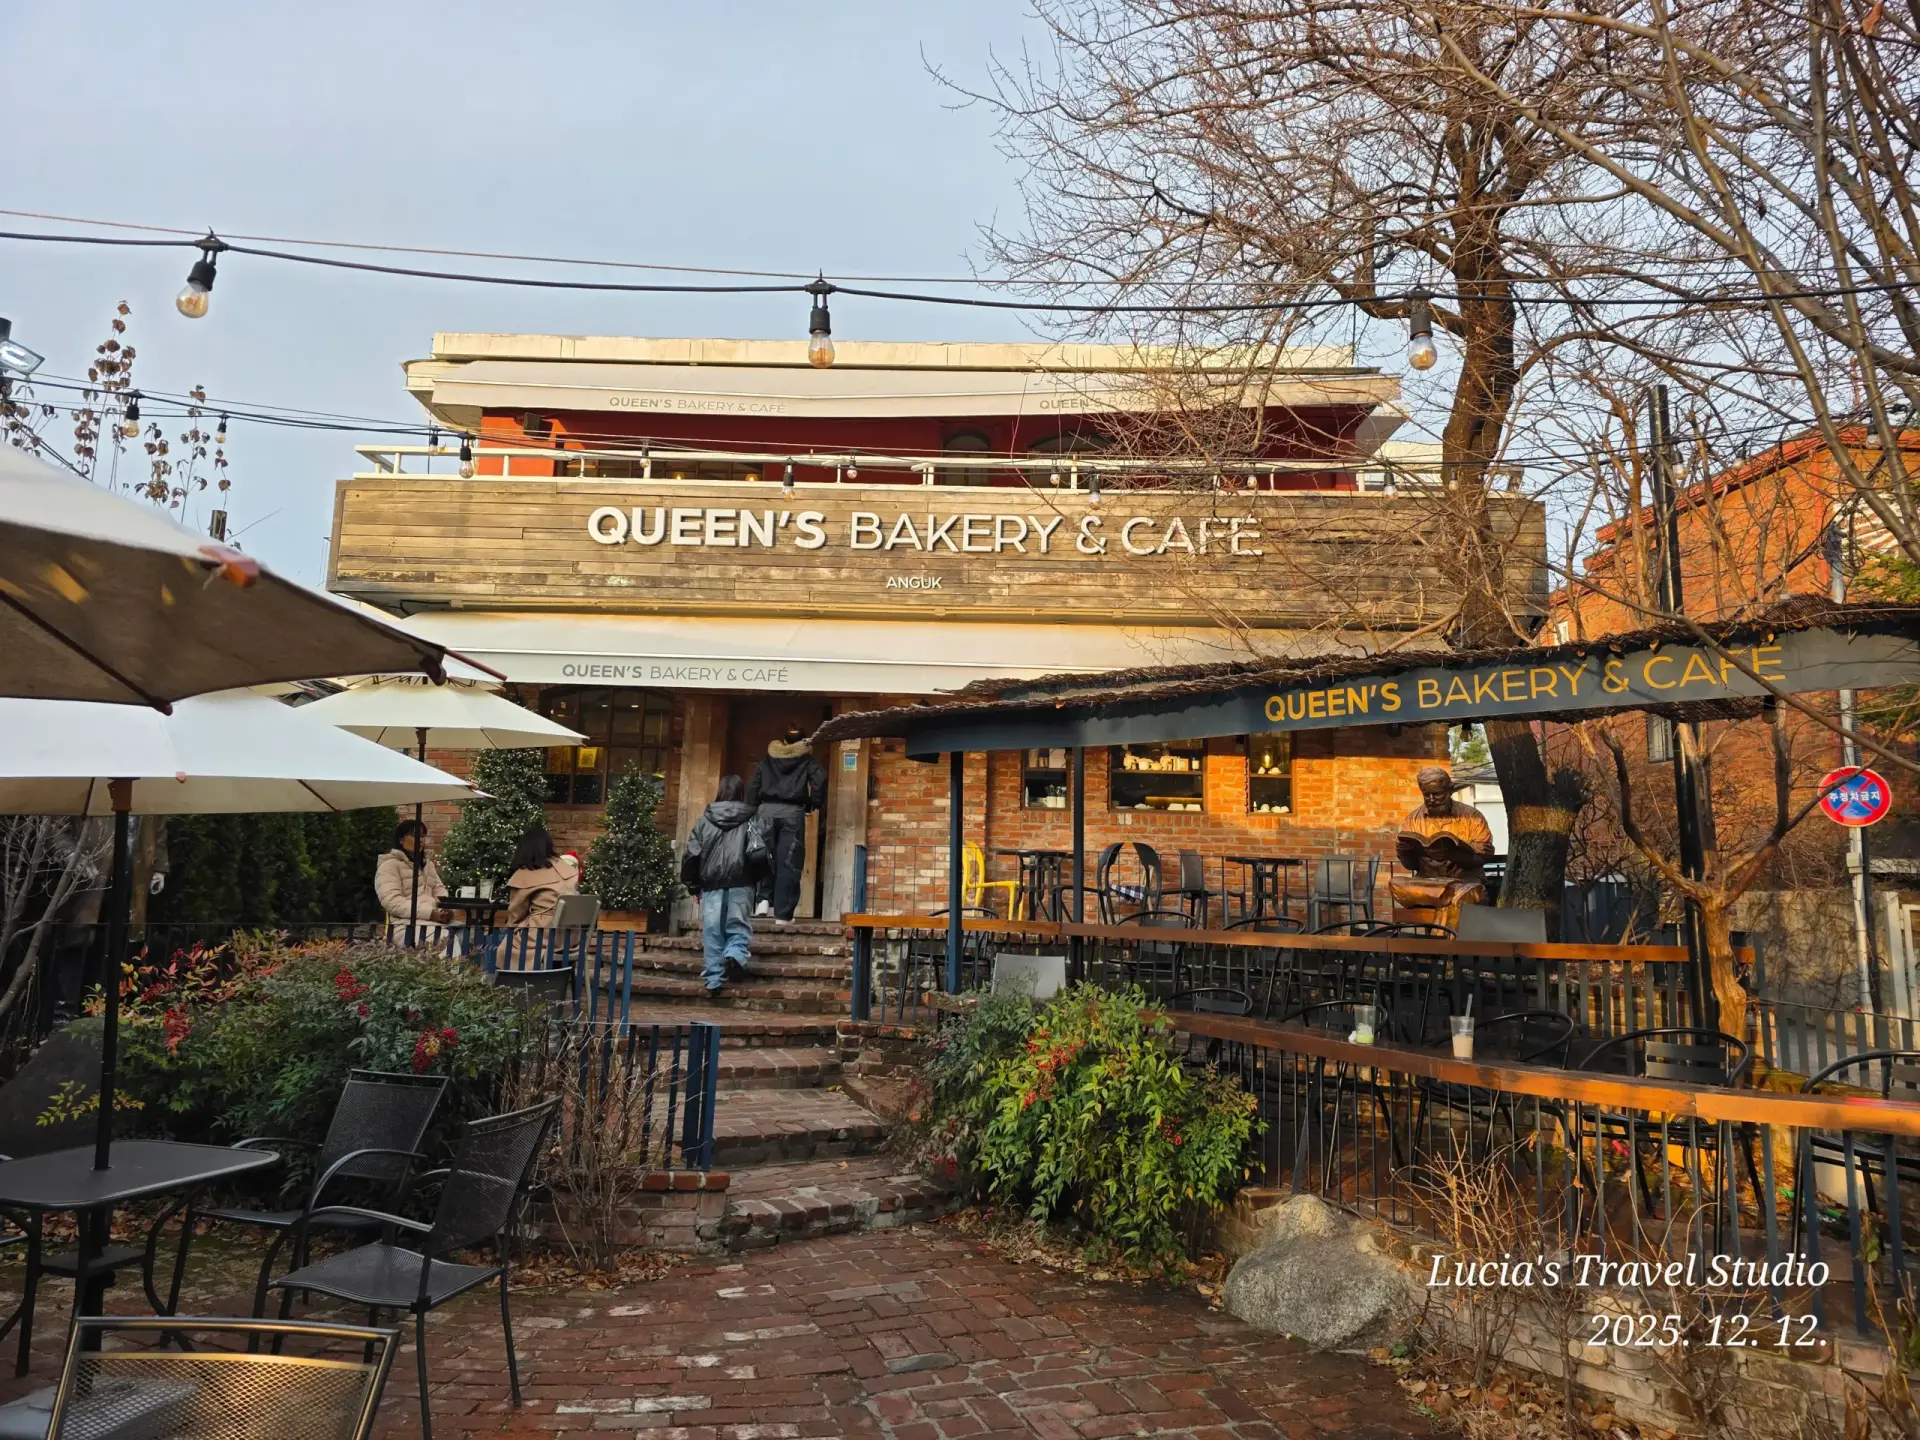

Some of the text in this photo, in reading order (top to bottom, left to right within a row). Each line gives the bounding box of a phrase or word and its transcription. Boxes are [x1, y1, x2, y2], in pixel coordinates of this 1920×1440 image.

[609, 397, 786, 413] QUEEN'S BAKERY & CAFÉ
[588, 507, 827, 549] QUEEN'S
[851, 511, 1064, 553] BAKERY
[1076, 515, 1107, 555] &
[886, 576, 942, 589] ANGUK
[562, 664, 788, 682] QUEEN'S BAKERY & CAFÉ
[1264, 682, 1402, 722] QUEEN'S
[1417, 663, 1587, 709] BAKERY
[1602, 660, 1630, 693] &
[1829, 791, 1880, 802] 주정차금지
